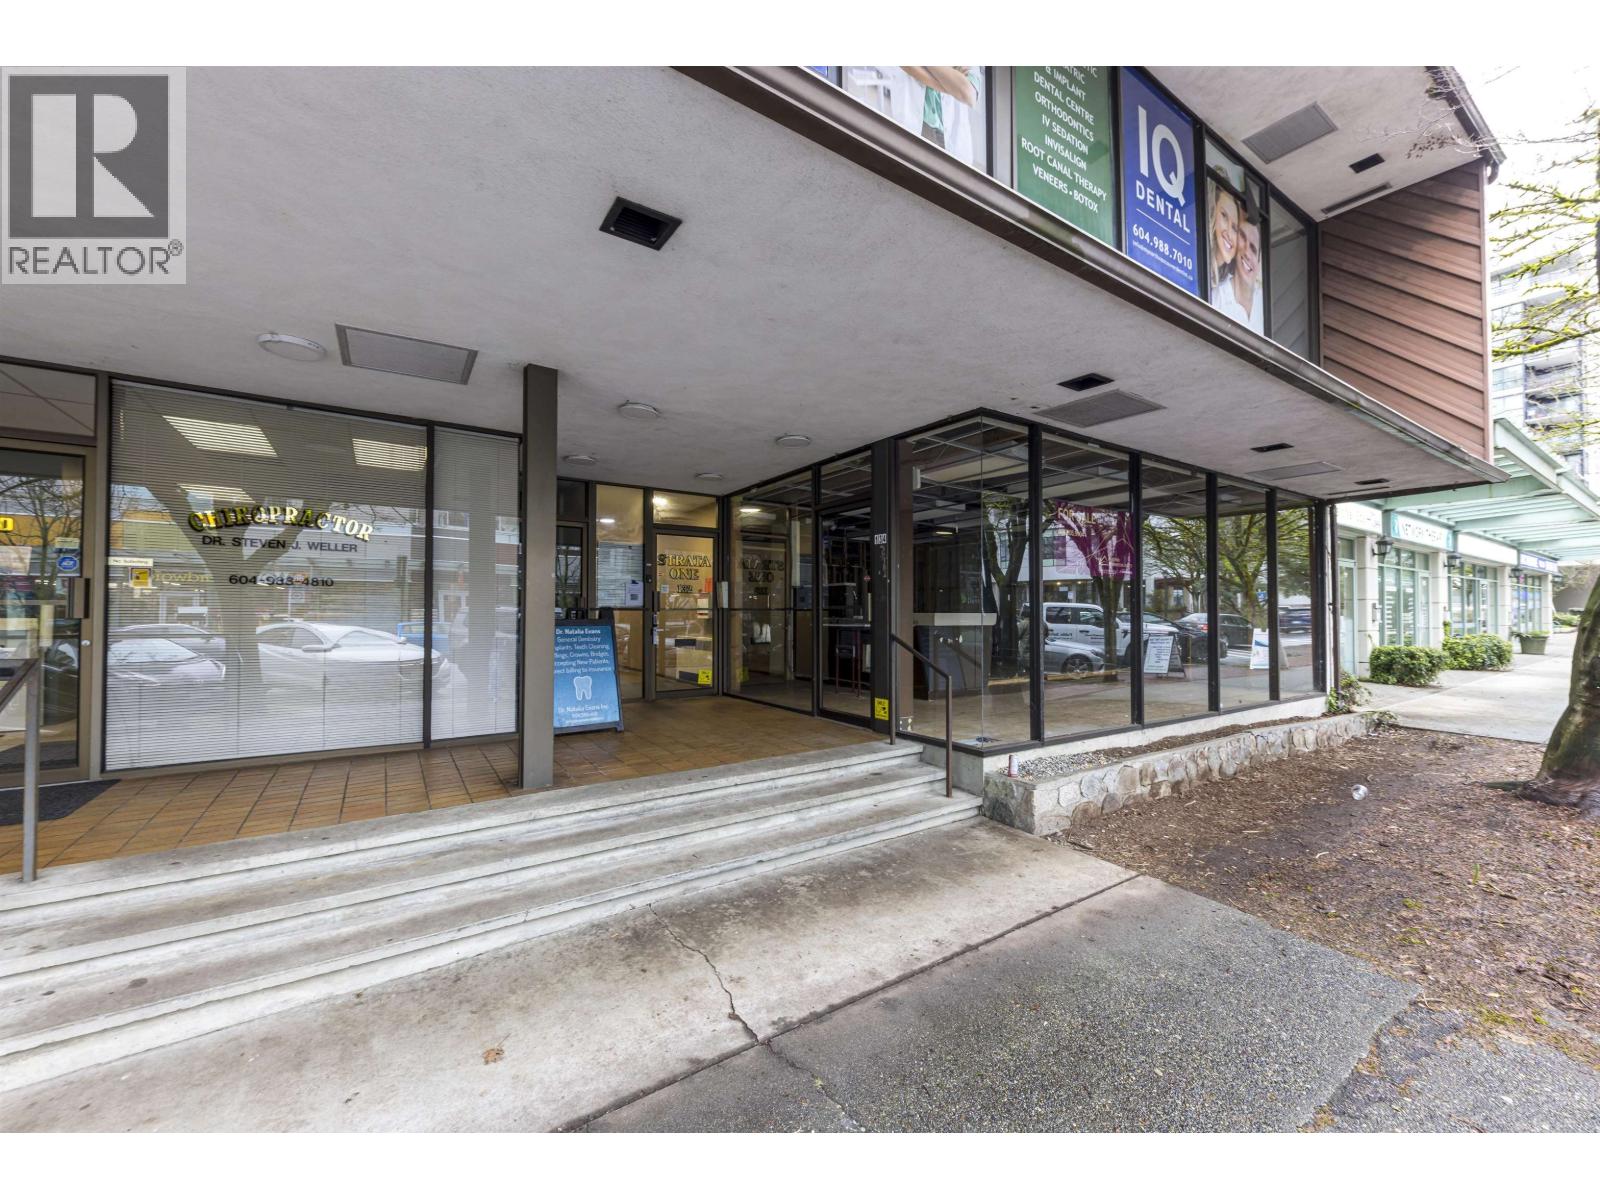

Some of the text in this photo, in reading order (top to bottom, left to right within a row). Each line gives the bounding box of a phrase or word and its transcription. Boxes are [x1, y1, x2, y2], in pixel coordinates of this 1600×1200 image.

[1033, 71, 1094, 125] DENTAL CENTRE
[1053, 69, 1086, 101] IMPLANT
[1034, 91, 1094, 142] ORTHODONTICS
[1041, 113, 1089, 155] IV SEDATION
[1021, 136, 1107, 201] ROOT CANAL THERAPY
[1044, 134, 1087, 171] INVISALIGN
[1137, 104, 1186, 208] IQ
[1032, 162, 1098, 213] VENEERS BOTOX
[1135, 179, 1191, 234] DENTAL
[1132, 224, 1193, 270] 604.988.7010
[187, 504, 374, 542] CHIROPRACTOR
[201, 535, 225, 546] DR.
[231, 537, 286, 549] STEVEN
[307, 541, 358, 553] WELLER
[657, 553, 711, 568] STRATA
[669, 567, 700, 580] ONE
